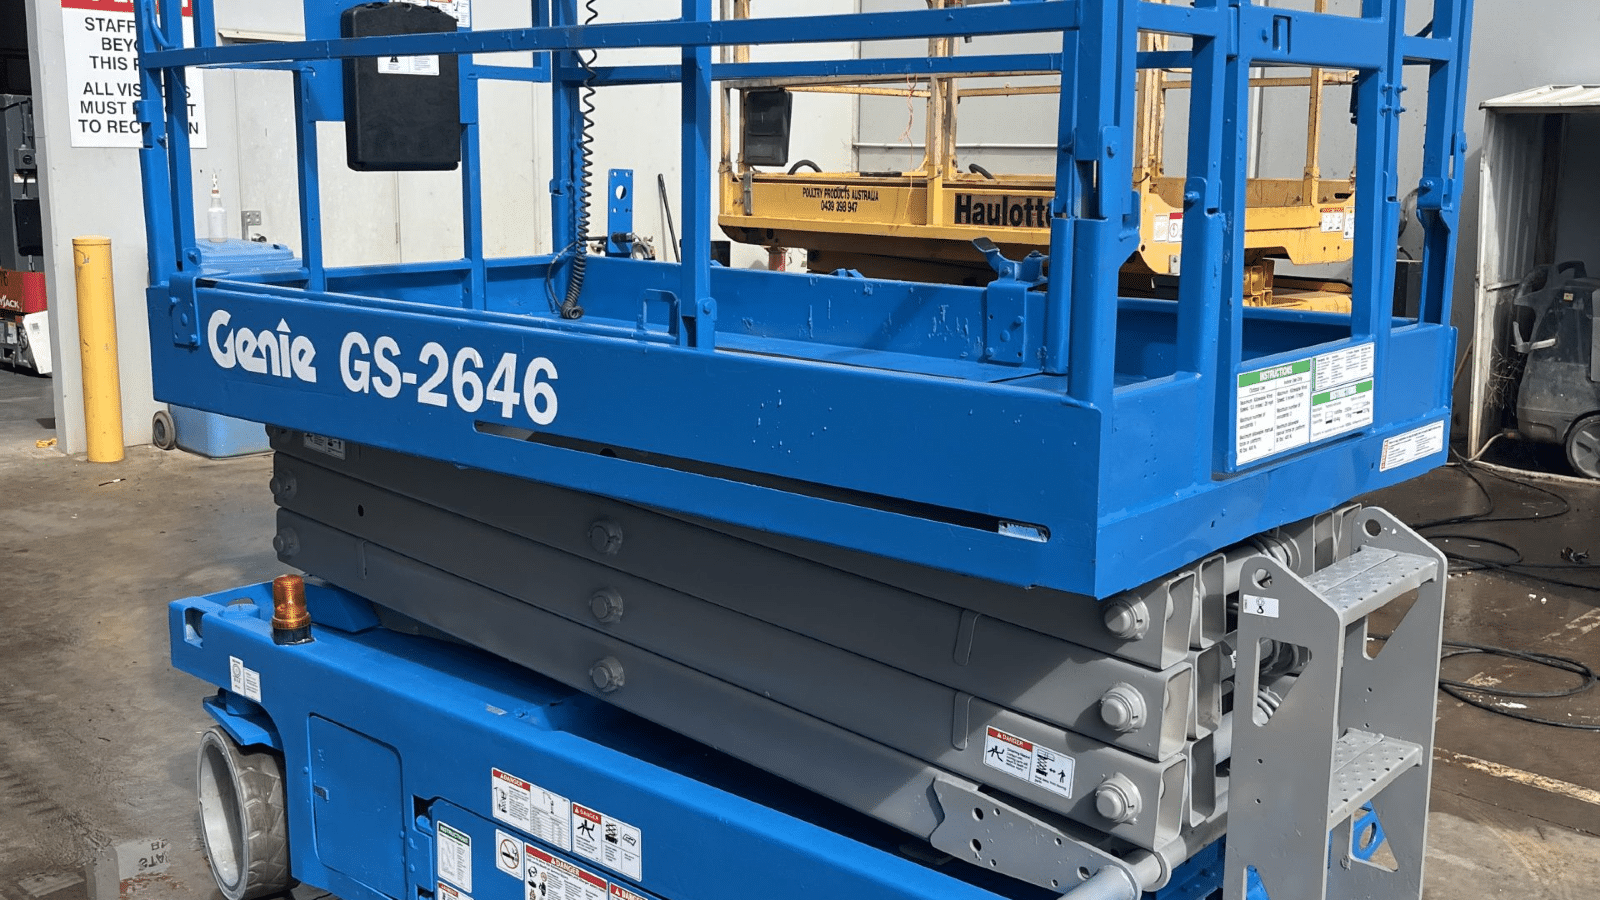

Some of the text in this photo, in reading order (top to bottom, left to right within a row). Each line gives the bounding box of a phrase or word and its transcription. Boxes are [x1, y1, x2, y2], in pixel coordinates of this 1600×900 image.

[84, 17, 136, 33] STAFF
[89, 56, 128, 71] THIS
[83, 82, 114, 96] ALL
[80, 101, 126, 115] MUST
[78, 119, 101, 133] TO
[802, 187, 879, 201] POULTRY PRODUCTS AUSTRALIA
[207, 309, 559, 426] Genie GS-2646
[1260, 365, 1292, 382] INSTRUCTIONS
[1003, 734, 1024, 747] DANGER
[503, 774, 523, 788] DANGER
[556, 859, 580, 876] DANGER
